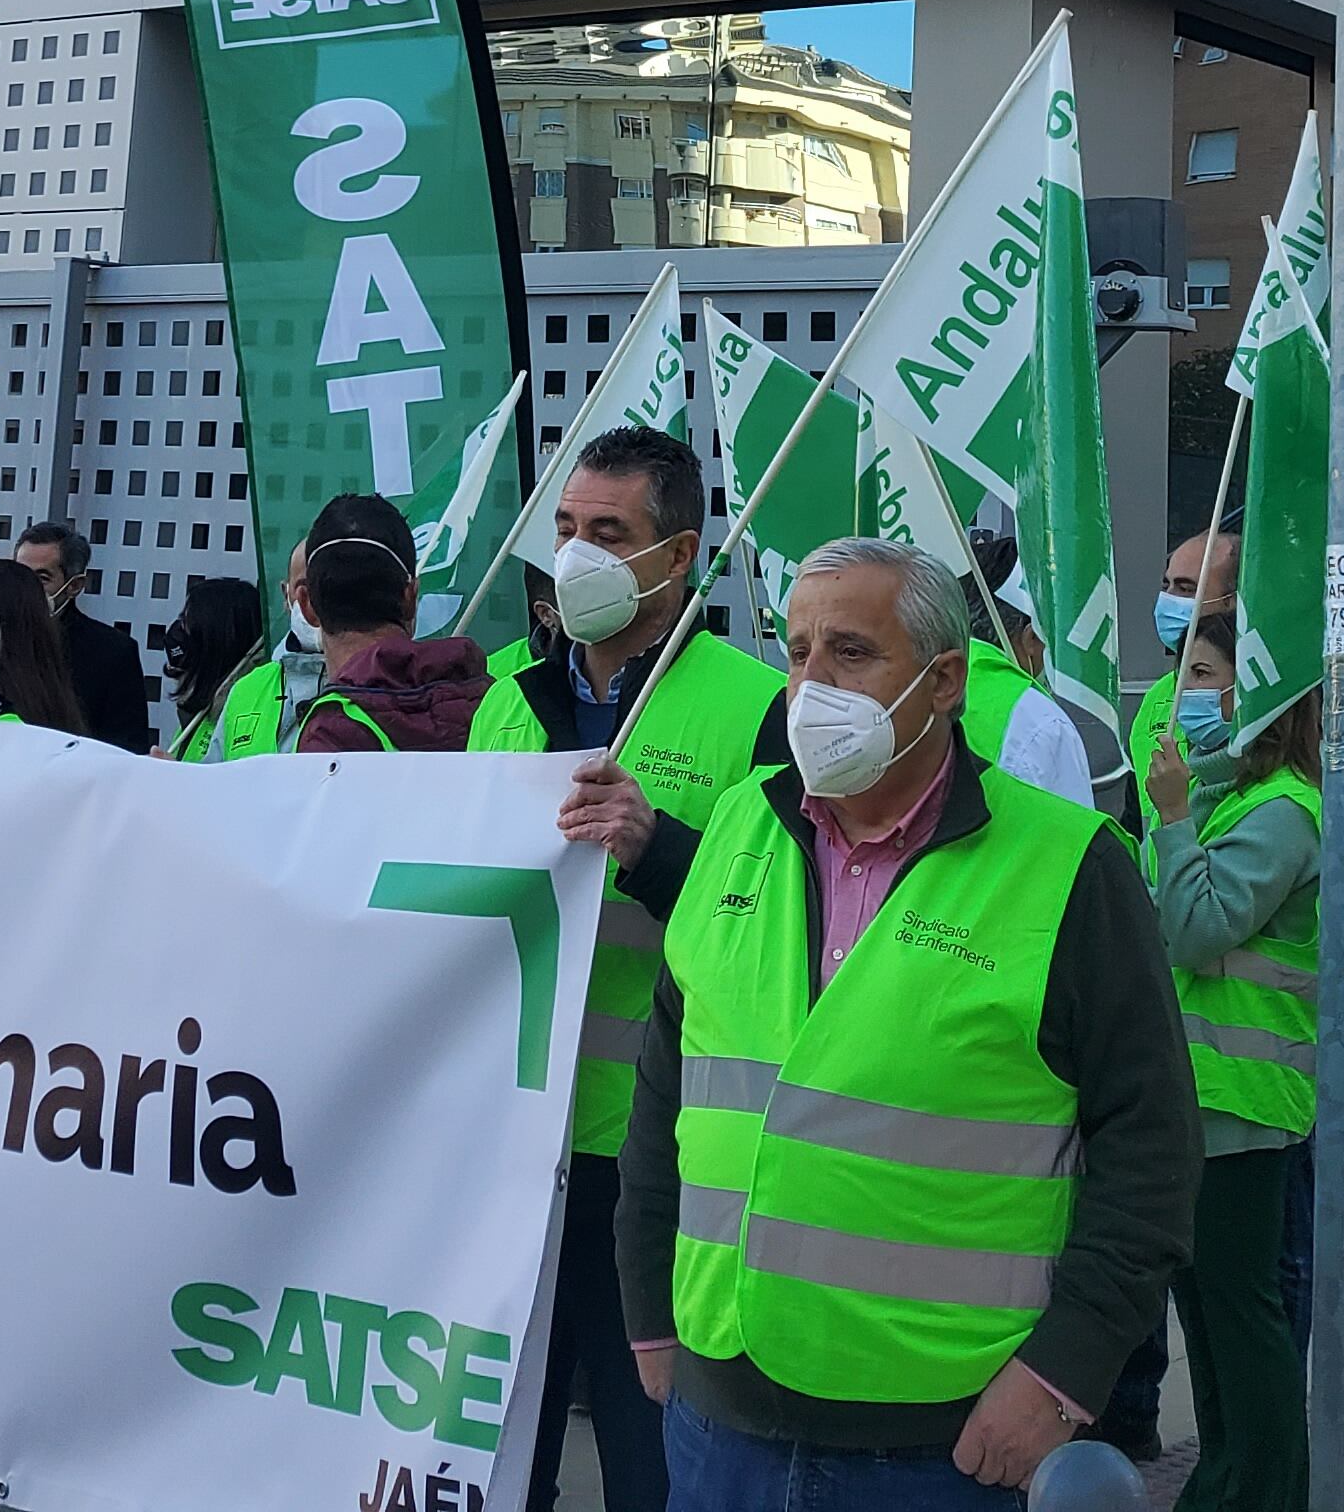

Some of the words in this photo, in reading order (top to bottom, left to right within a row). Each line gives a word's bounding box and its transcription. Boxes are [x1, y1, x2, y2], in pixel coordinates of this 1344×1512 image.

[640, 744, 694, 766] Sindicato
[635, 759, 650, 773] de
[651, 762, 714, 788] Enfermería
[654, 779, 682, 792] JAÉN
[902, 910, 970, 940] Sindicato
[894, 928, 914, 944] de
[915, 935, 996, 972] Enfermería
[171, 1281, 512, 1454] SATSE
